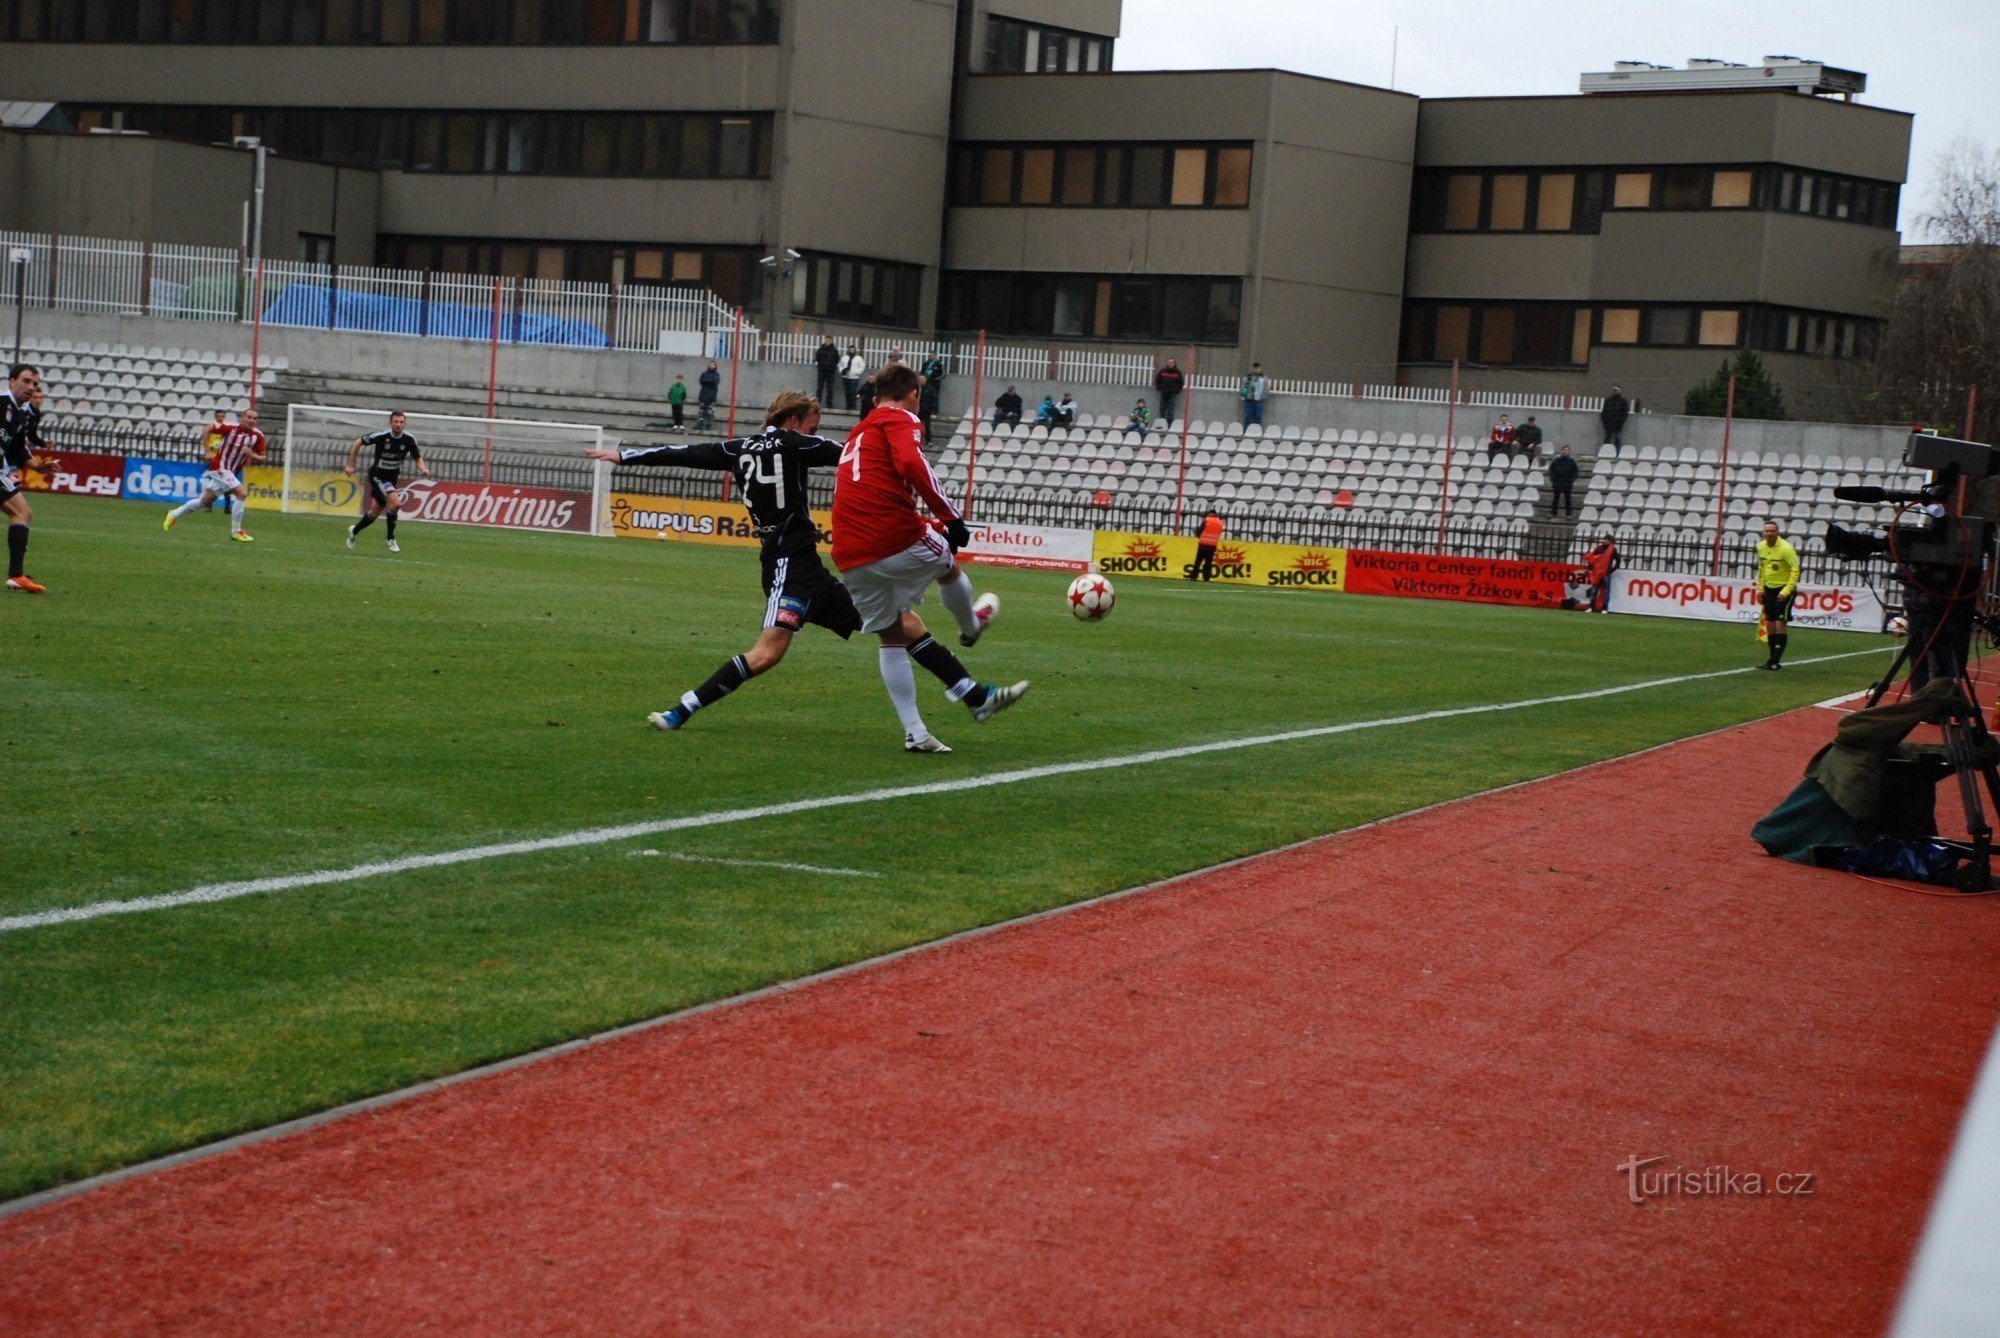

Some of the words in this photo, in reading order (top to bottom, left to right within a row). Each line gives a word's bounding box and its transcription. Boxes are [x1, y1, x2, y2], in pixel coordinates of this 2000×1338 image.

[840, 432, 865, 482] 4
[51, 472, 121, 496] PLAY
[739, 453, 785, 509] 24
[396, 479, 576, 529] Gambrinus
[631, 510, 713, 535] IMPULS
[974, 526, 1043, 547] elektro
[1134, 544, 1153, 554] BIG
[1218, 551, 1238, 560] BIG
[1100, 556, 1167, 572] SHOCK!
[1183, 563, 1252, 579] SOCK!
[1303, 557, 1323, 567] BIG
[1352, 554, 1420, 572] Viktoria
[1426, 559, 1485, 577] Center
[1268, 569, 1337, 586] SHOCK!
[1392, 577, 1460, 596] Viktoria
[1465, 578, 1524, 600] Žižkov
[1628, 578, 1732, 610] morphy
[1739, 582, 1854, 613] riards
